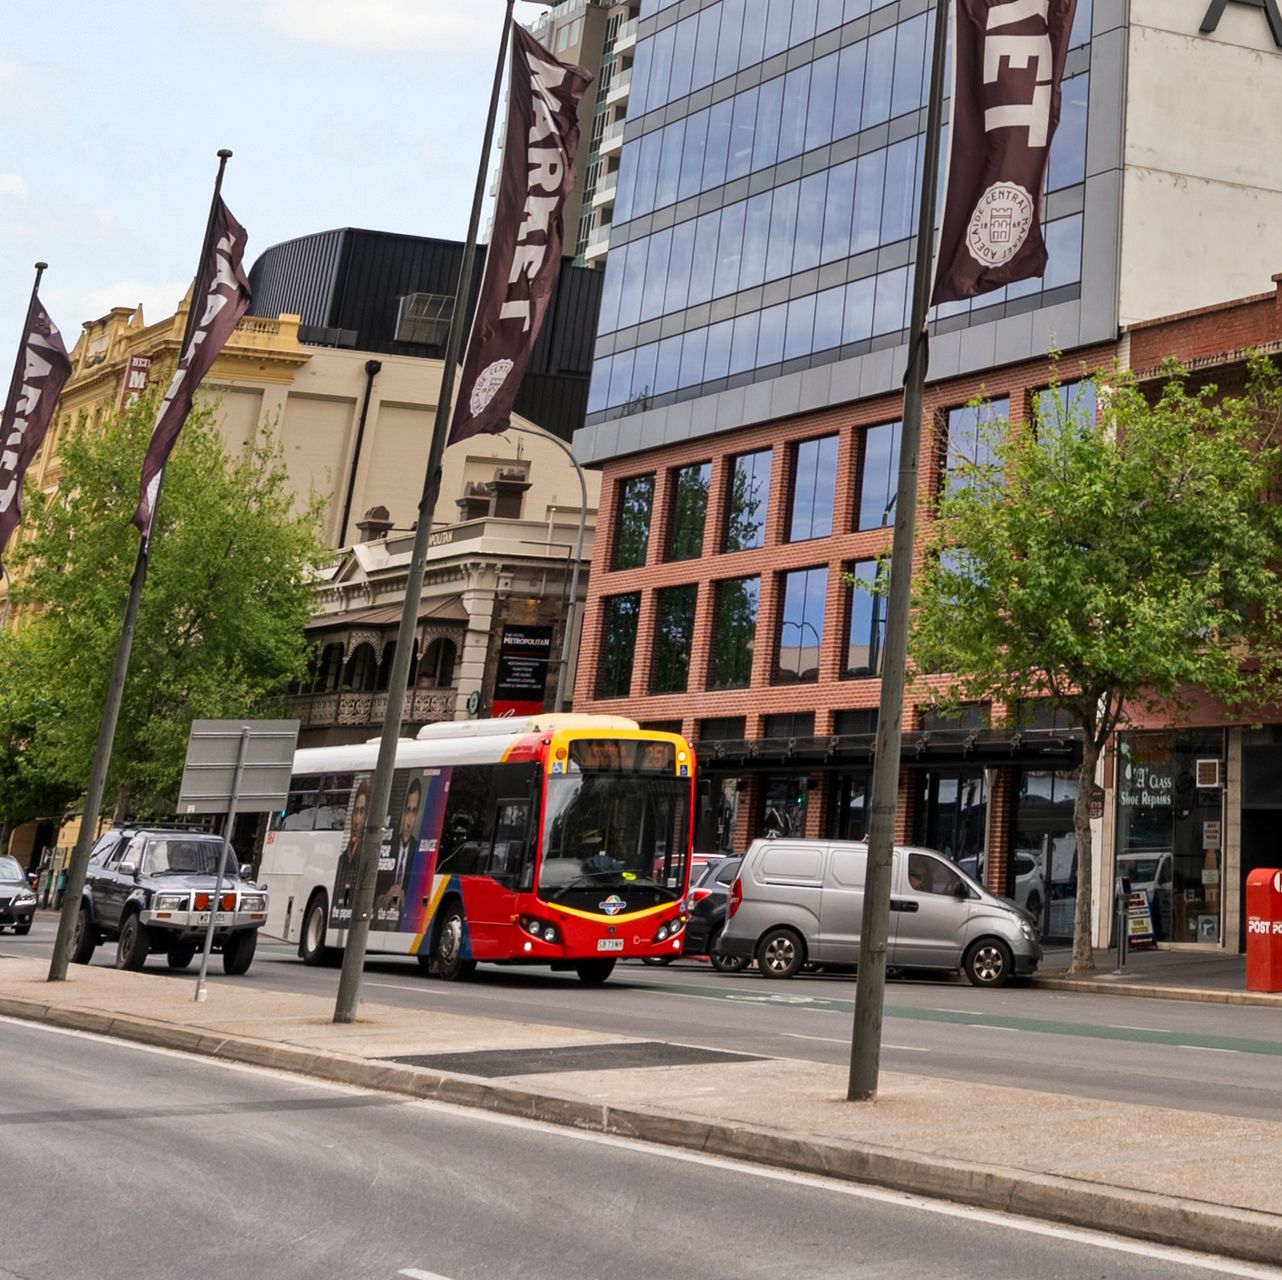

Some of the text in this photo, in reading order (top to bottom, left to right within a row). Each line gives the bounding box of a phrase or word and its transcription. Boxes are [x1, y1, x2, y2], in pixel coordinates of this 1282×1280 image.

[985, 190, 1029, 214] CENTRAL
[503, 637, 551, 647] METROPOLITAN
[1248, 920, 1271, 934] POST
